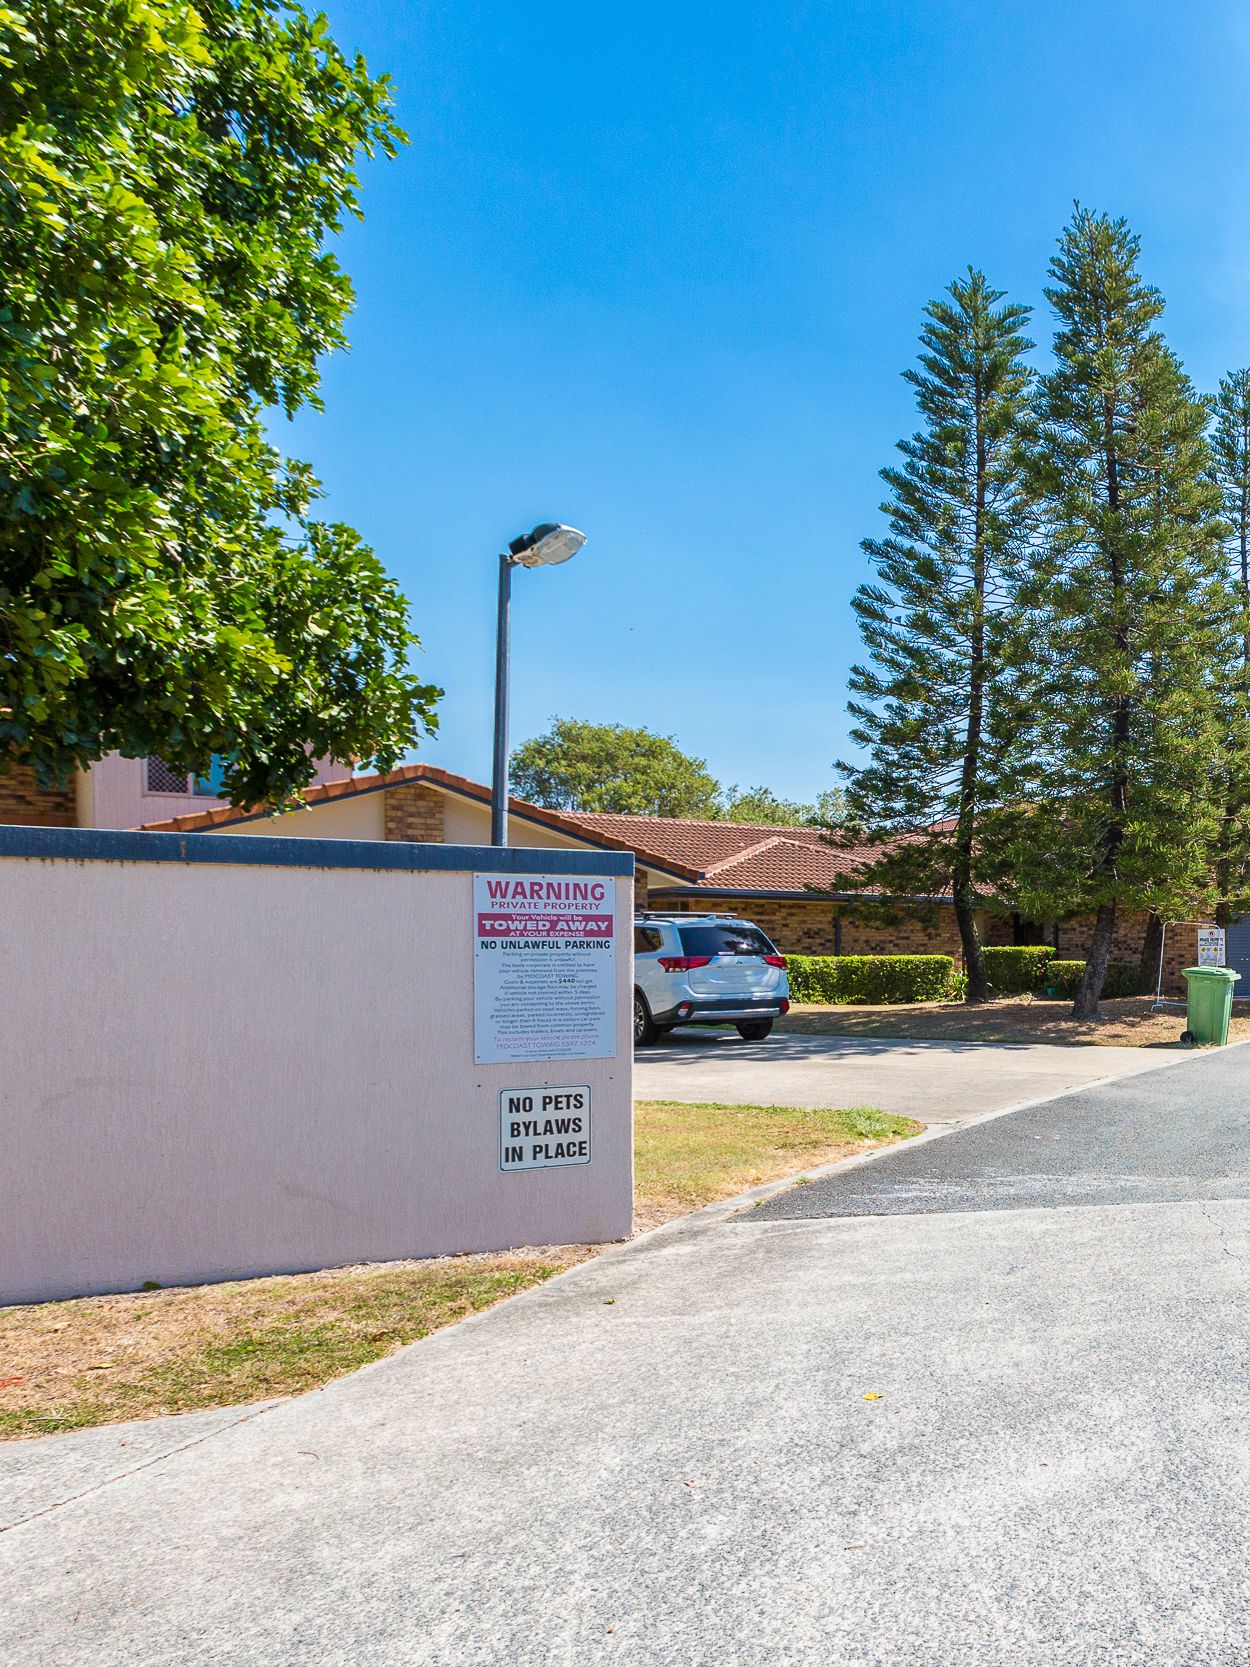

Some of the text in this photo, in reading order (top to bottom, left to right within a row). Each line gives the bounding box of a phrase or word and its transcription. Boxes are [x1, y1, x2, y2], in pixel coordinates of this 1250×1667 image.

[487, 880, 605, 901] WARNING
[491, 901, 600, 911] PRIVATE PROPERTY
[482, 920, 609, 931] TOWED AWAY
[481, 940, 610, 950] NO UNLAWFUL PARKING
[508, 1093, 584, 1114] NO PETS
[510, 1117, 582, 1138] BYLAWS
[505, 1140, 588, 1163] IN PLACE
